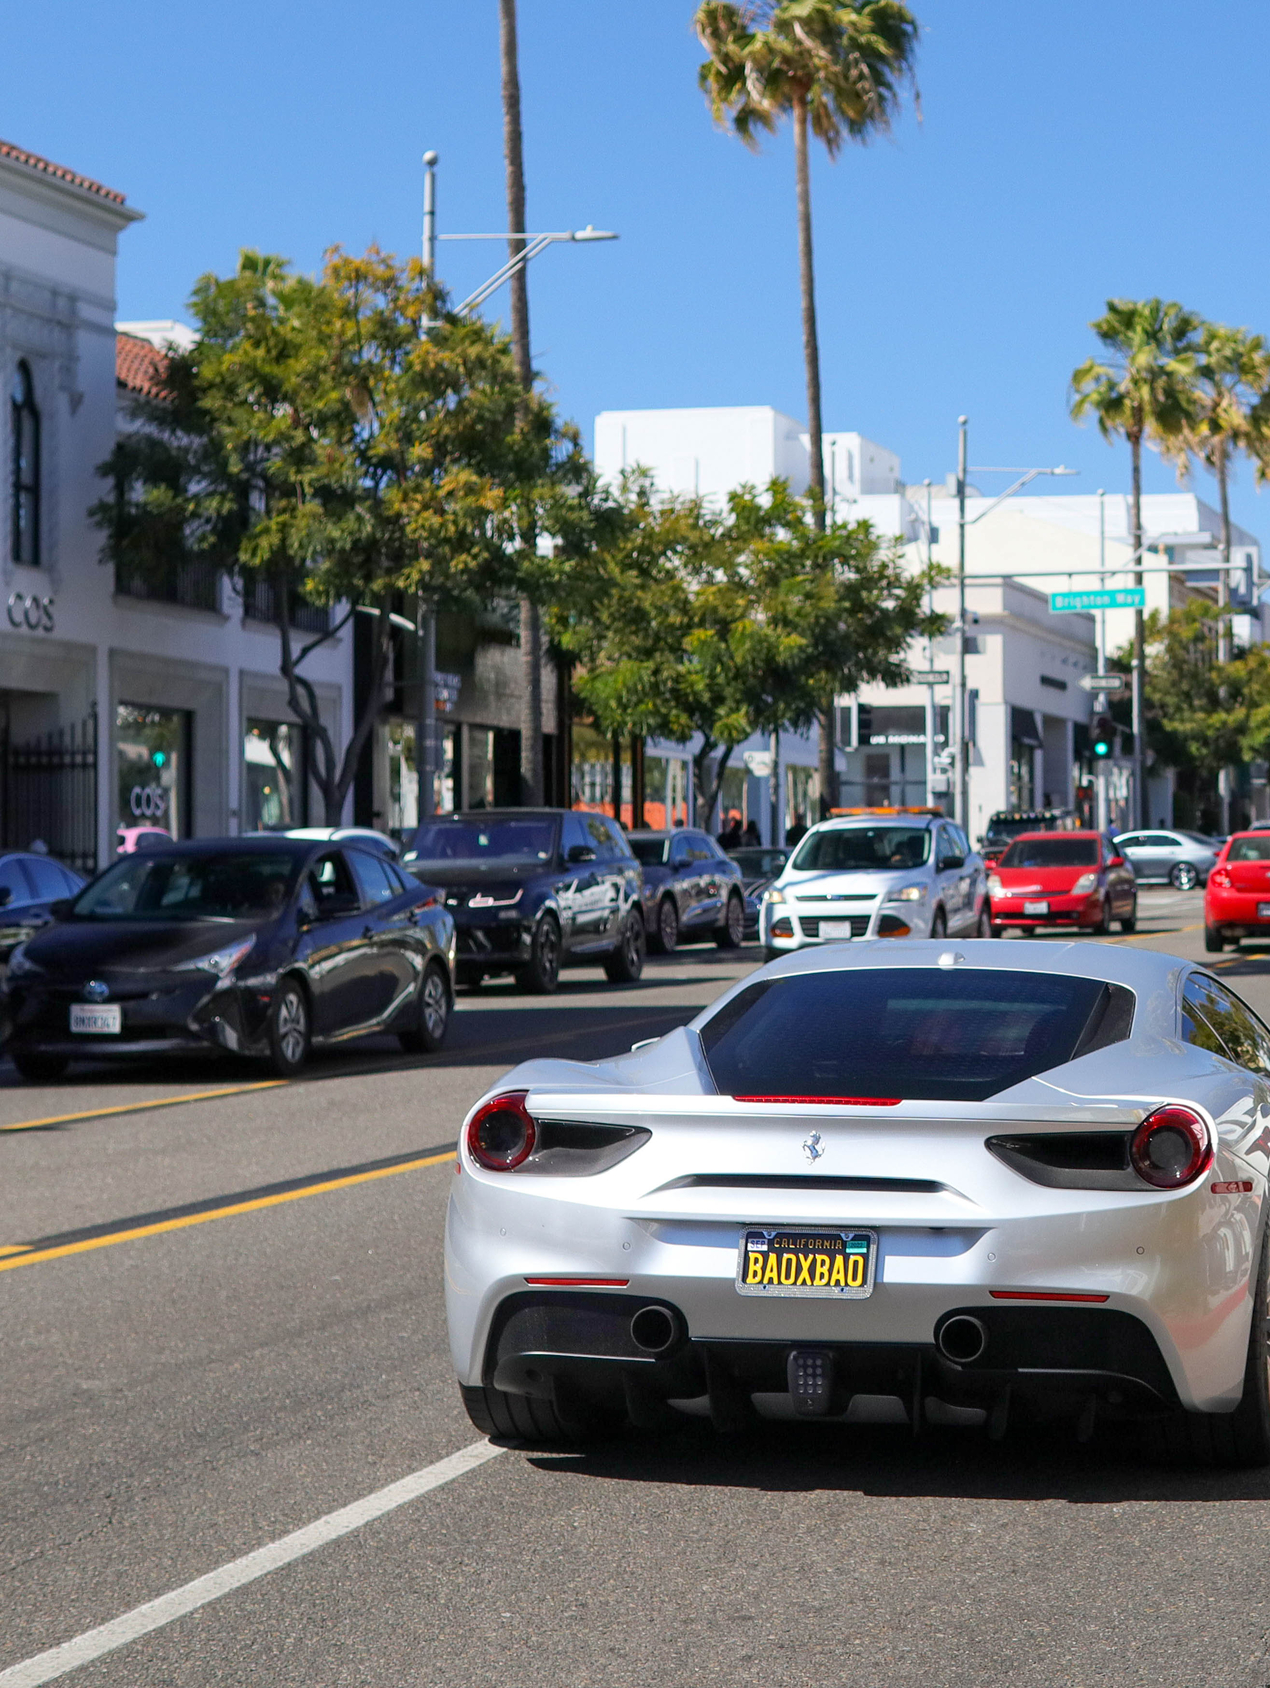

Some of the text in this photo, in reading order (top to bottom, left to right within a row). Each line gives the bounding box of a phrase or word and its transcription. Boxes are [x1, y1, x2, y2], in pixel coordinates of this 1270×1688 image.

[7, 592, 54, 632] COS
[1055, 592, 1141, 609] Brighton Way
[130, 785, 165, 817] COS
[773, 1238, 843, 1250] CALIFORNIA
[746, 1251, 864, 1287] BAOXBAO
